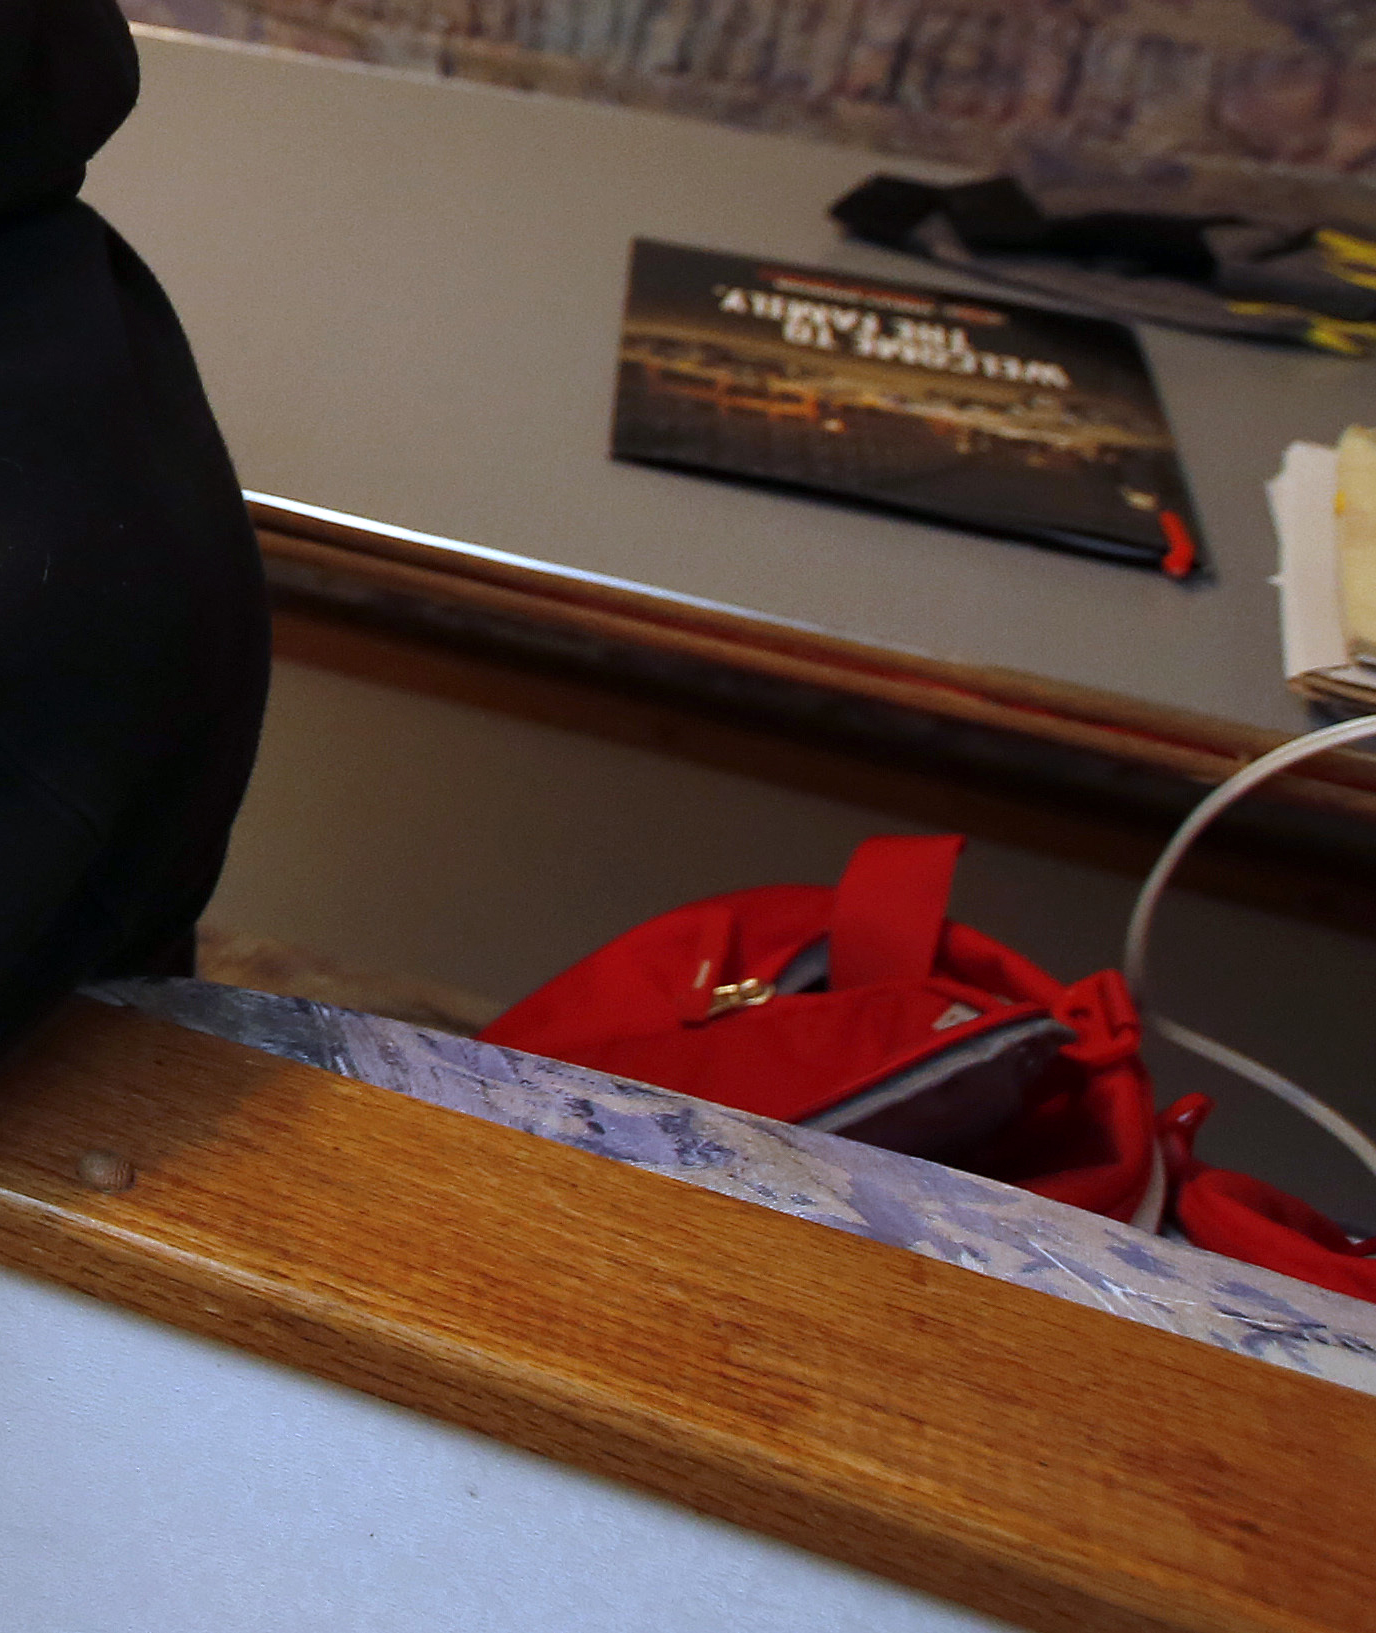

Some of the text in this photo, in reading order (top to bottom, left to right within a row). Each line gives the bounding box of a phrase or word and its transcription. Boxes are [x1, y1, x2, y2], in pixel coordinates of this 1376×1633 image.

[782, 315, 1071, 389] WELCOME TO
[894, 315, 968, 356] THE
